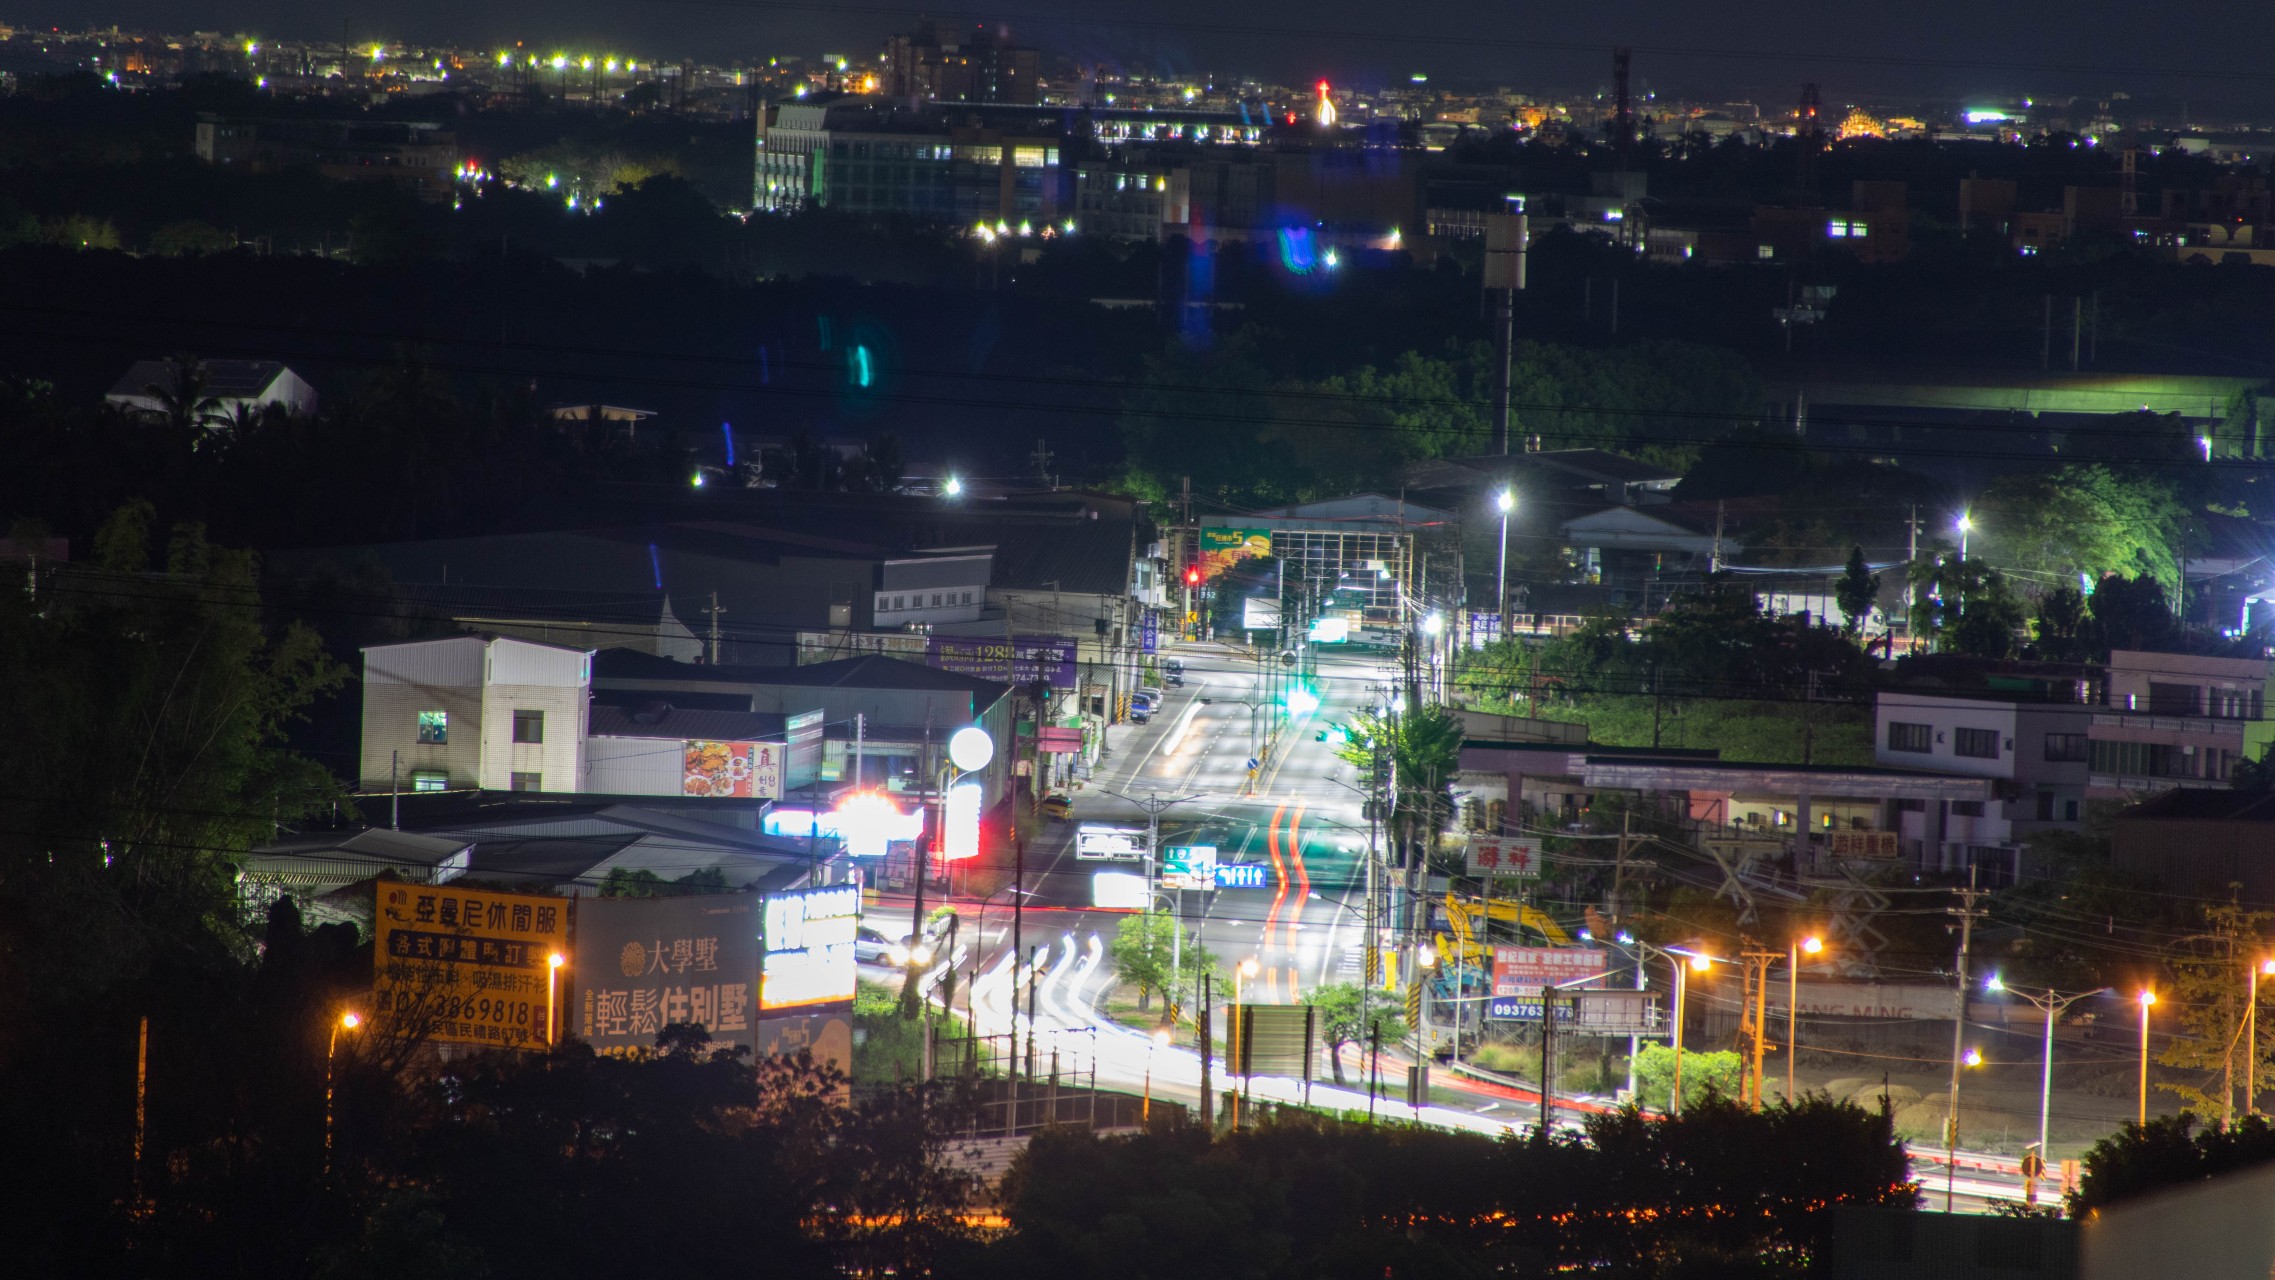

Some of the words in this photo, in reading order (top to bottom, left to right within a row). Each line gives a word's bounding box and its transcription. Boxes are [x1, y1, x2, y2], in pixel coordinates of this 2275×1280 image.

[416, 895, 556, 934] 亞曼尼休閒服
[647, 936, 719, 976] 大學墅
[595, 983, 749, 1036] 輕鬆住別墅
